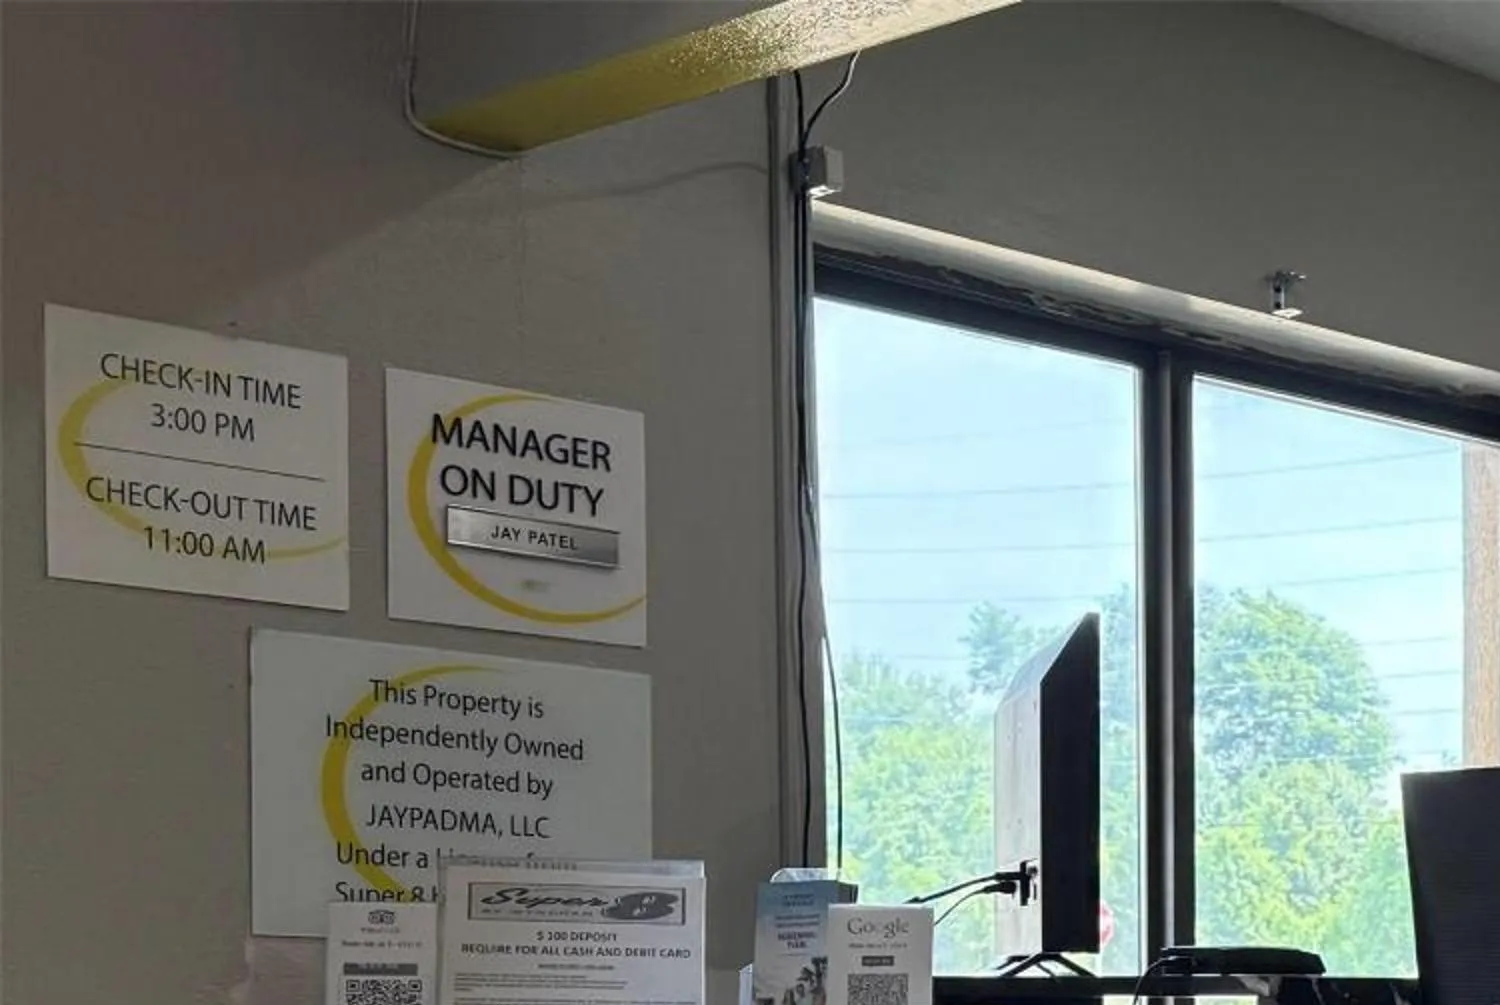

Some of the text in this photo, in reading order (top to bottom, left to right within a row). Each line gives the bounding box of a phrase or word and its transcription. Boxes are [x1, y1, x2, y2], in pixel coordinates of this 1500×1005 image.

[100, 352, 302, 409] CHECK-IN TIME
[150, 403, 255, 442] 3:00 PM
[431, 412, 611, 472] MANAGER
[85, 476, 317, 532] CHECK-OUT TIME
[439, 464, 604, 517] ON DUTY
[142, 525, 266, 564] 11:00 AM
[490, 525, 578, 551] JAY PATEL
[369, 679, 544, 720] This Property is
[326, 715, 583, 761] Independently Owned
[360, 760, 553, 800] and Operated by
[365, 805, 551, 839] JAYPADMA, LLC
[336, 842, 409, 868] Under
[416, 850, 428, 869] a
[480, 887, 608, 908] Super
[515, 945, 538, 955] FOR
[541, 945, 560, 956] ALL
[563, 946, 593, 956] CASH
[596, 947, 622, 957] AND
[625, 948, 655, 958] DEBIT
[659, 949, 691, 959] CARD
[547, 931, 568, 941] 100
[570, 931, 617, 942] DEPOSIT
